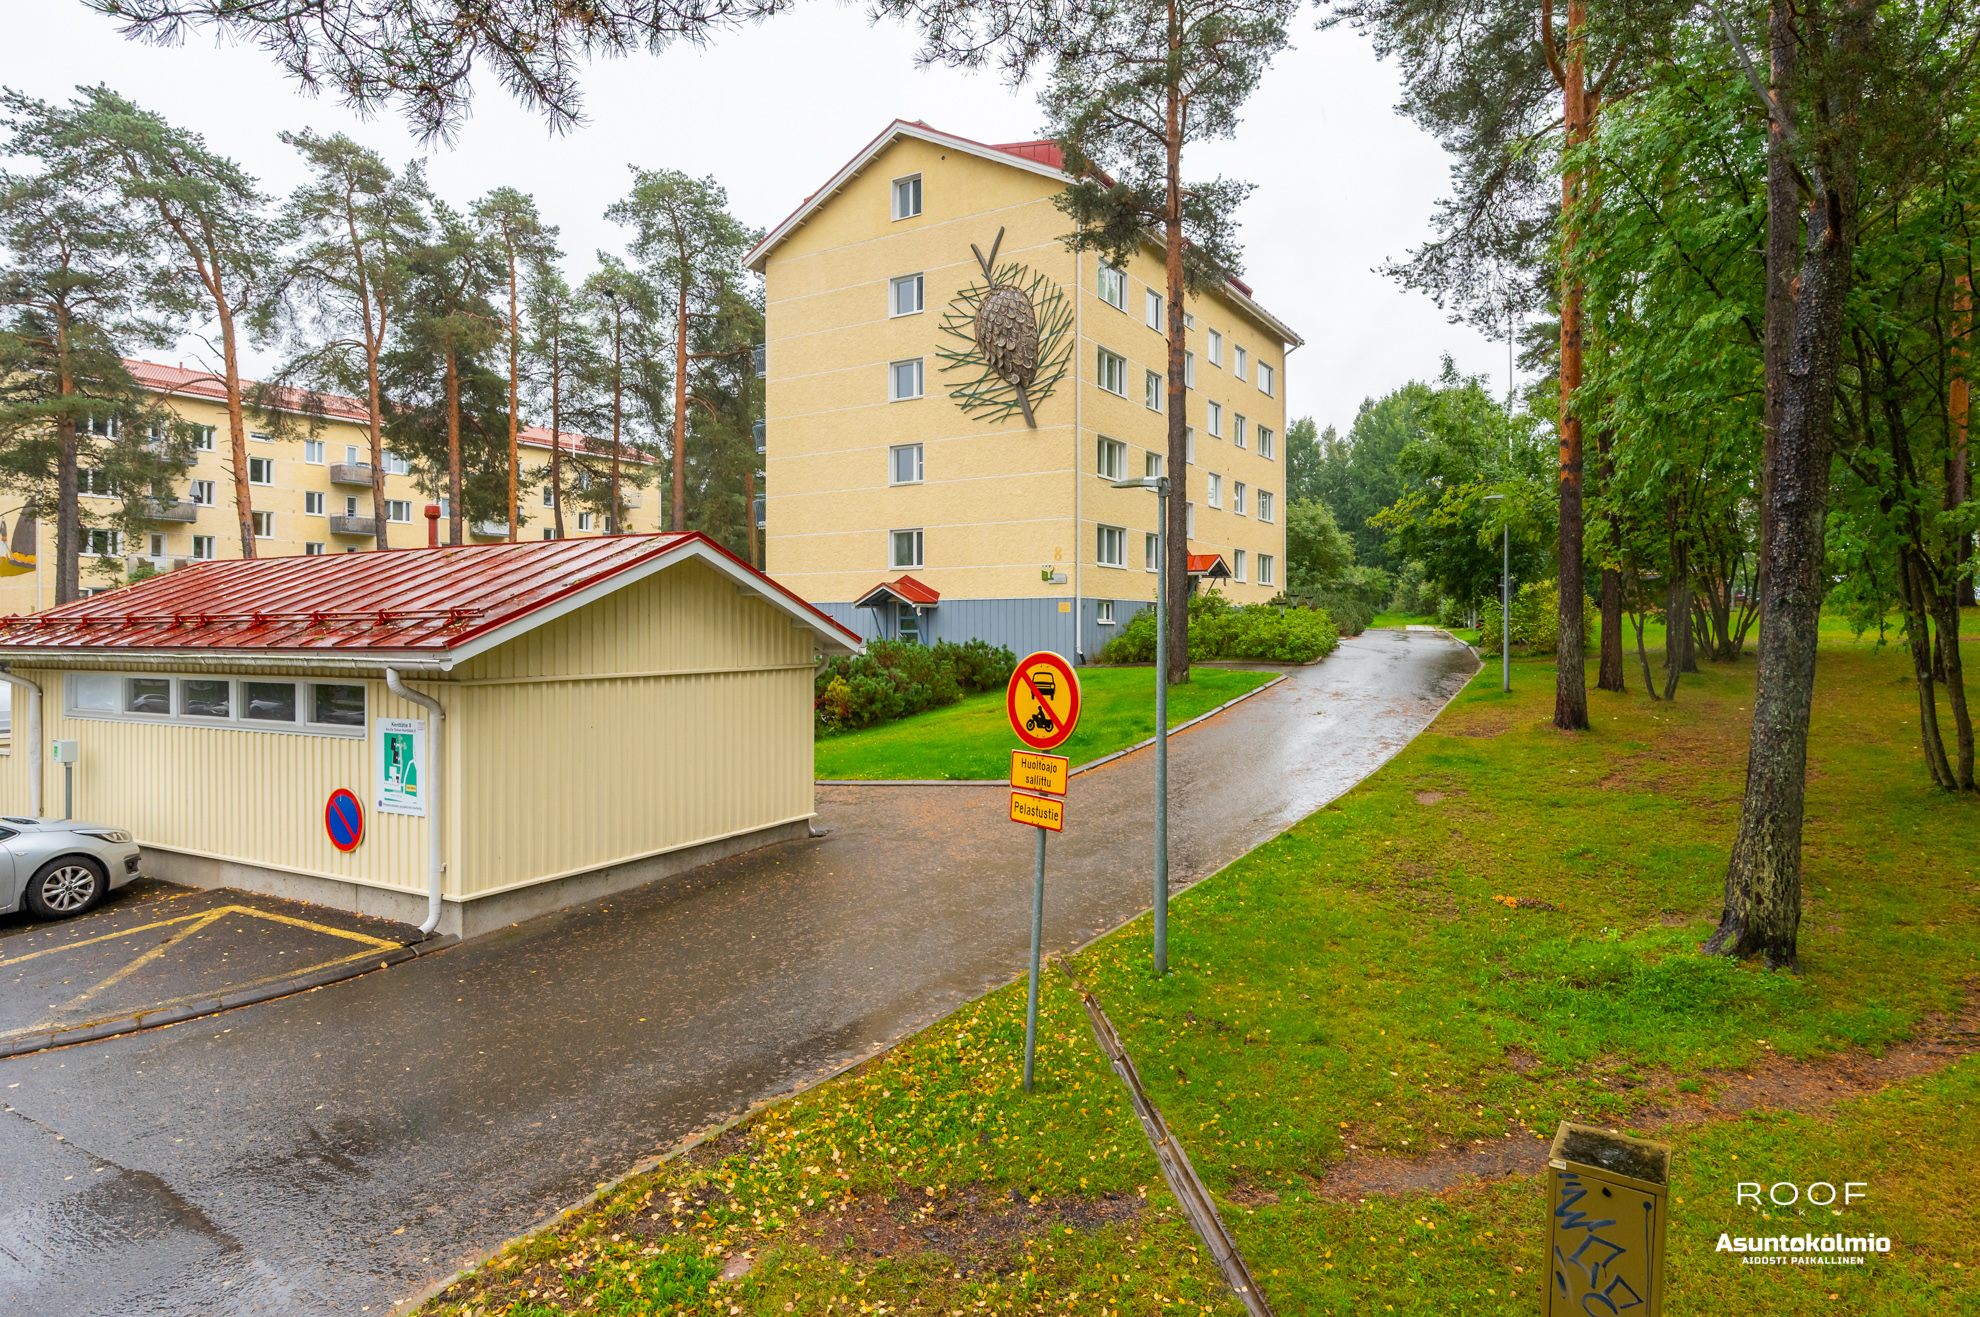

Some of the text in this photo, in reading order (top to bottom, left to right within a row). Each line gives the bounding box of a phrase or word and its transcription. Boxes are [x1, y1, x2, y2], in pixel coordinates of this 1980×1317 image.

[1054, 546, 1062, 561] 8
[1021, 758, 1057, 774] Huoltoajo
[1025, 774, 1052, 788] sallittu
[1014, 801, 1059, 821] Pelastustie
